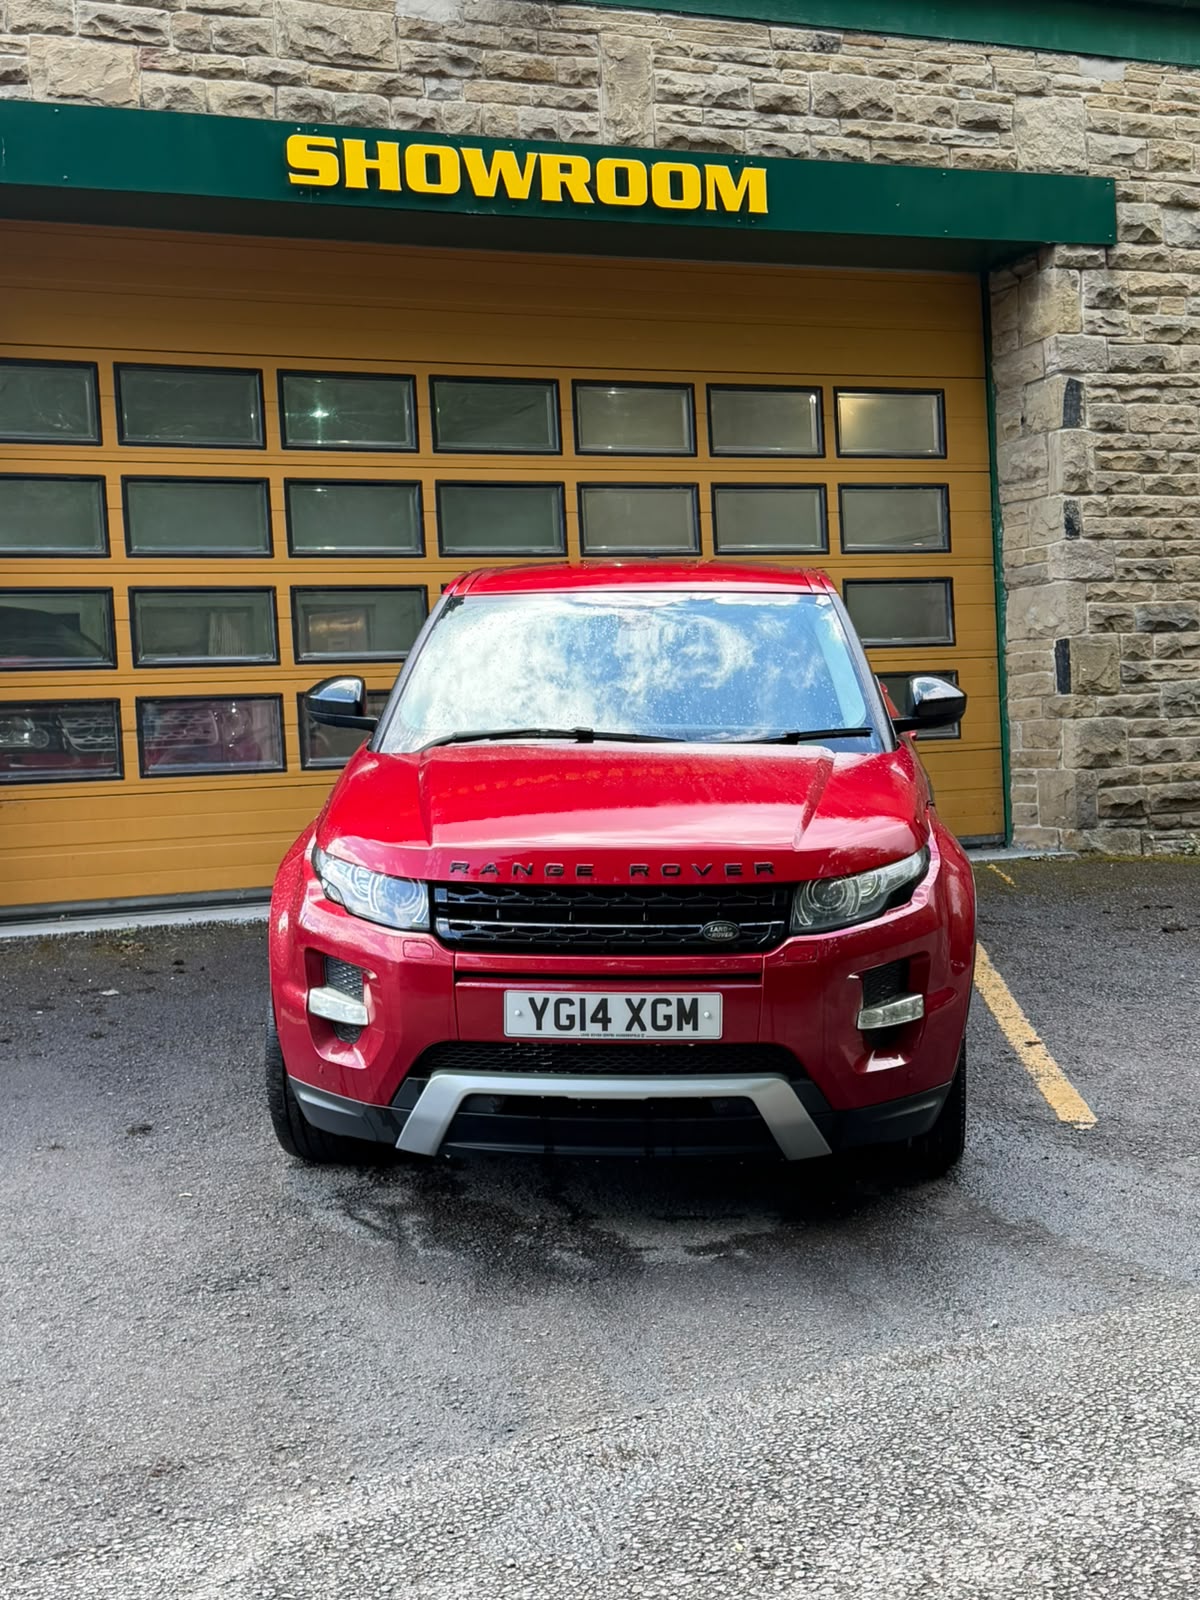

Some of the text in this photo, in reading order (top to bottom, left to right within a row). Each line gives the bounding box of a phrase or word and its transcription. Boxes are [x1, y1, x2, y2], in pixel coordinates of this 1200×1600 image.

[286, 134, 768, 214] SHOWROOM
[449, 861, 776, 878] RANGE ROVER
[528, 997, 699, 1032] YG14 XGM
